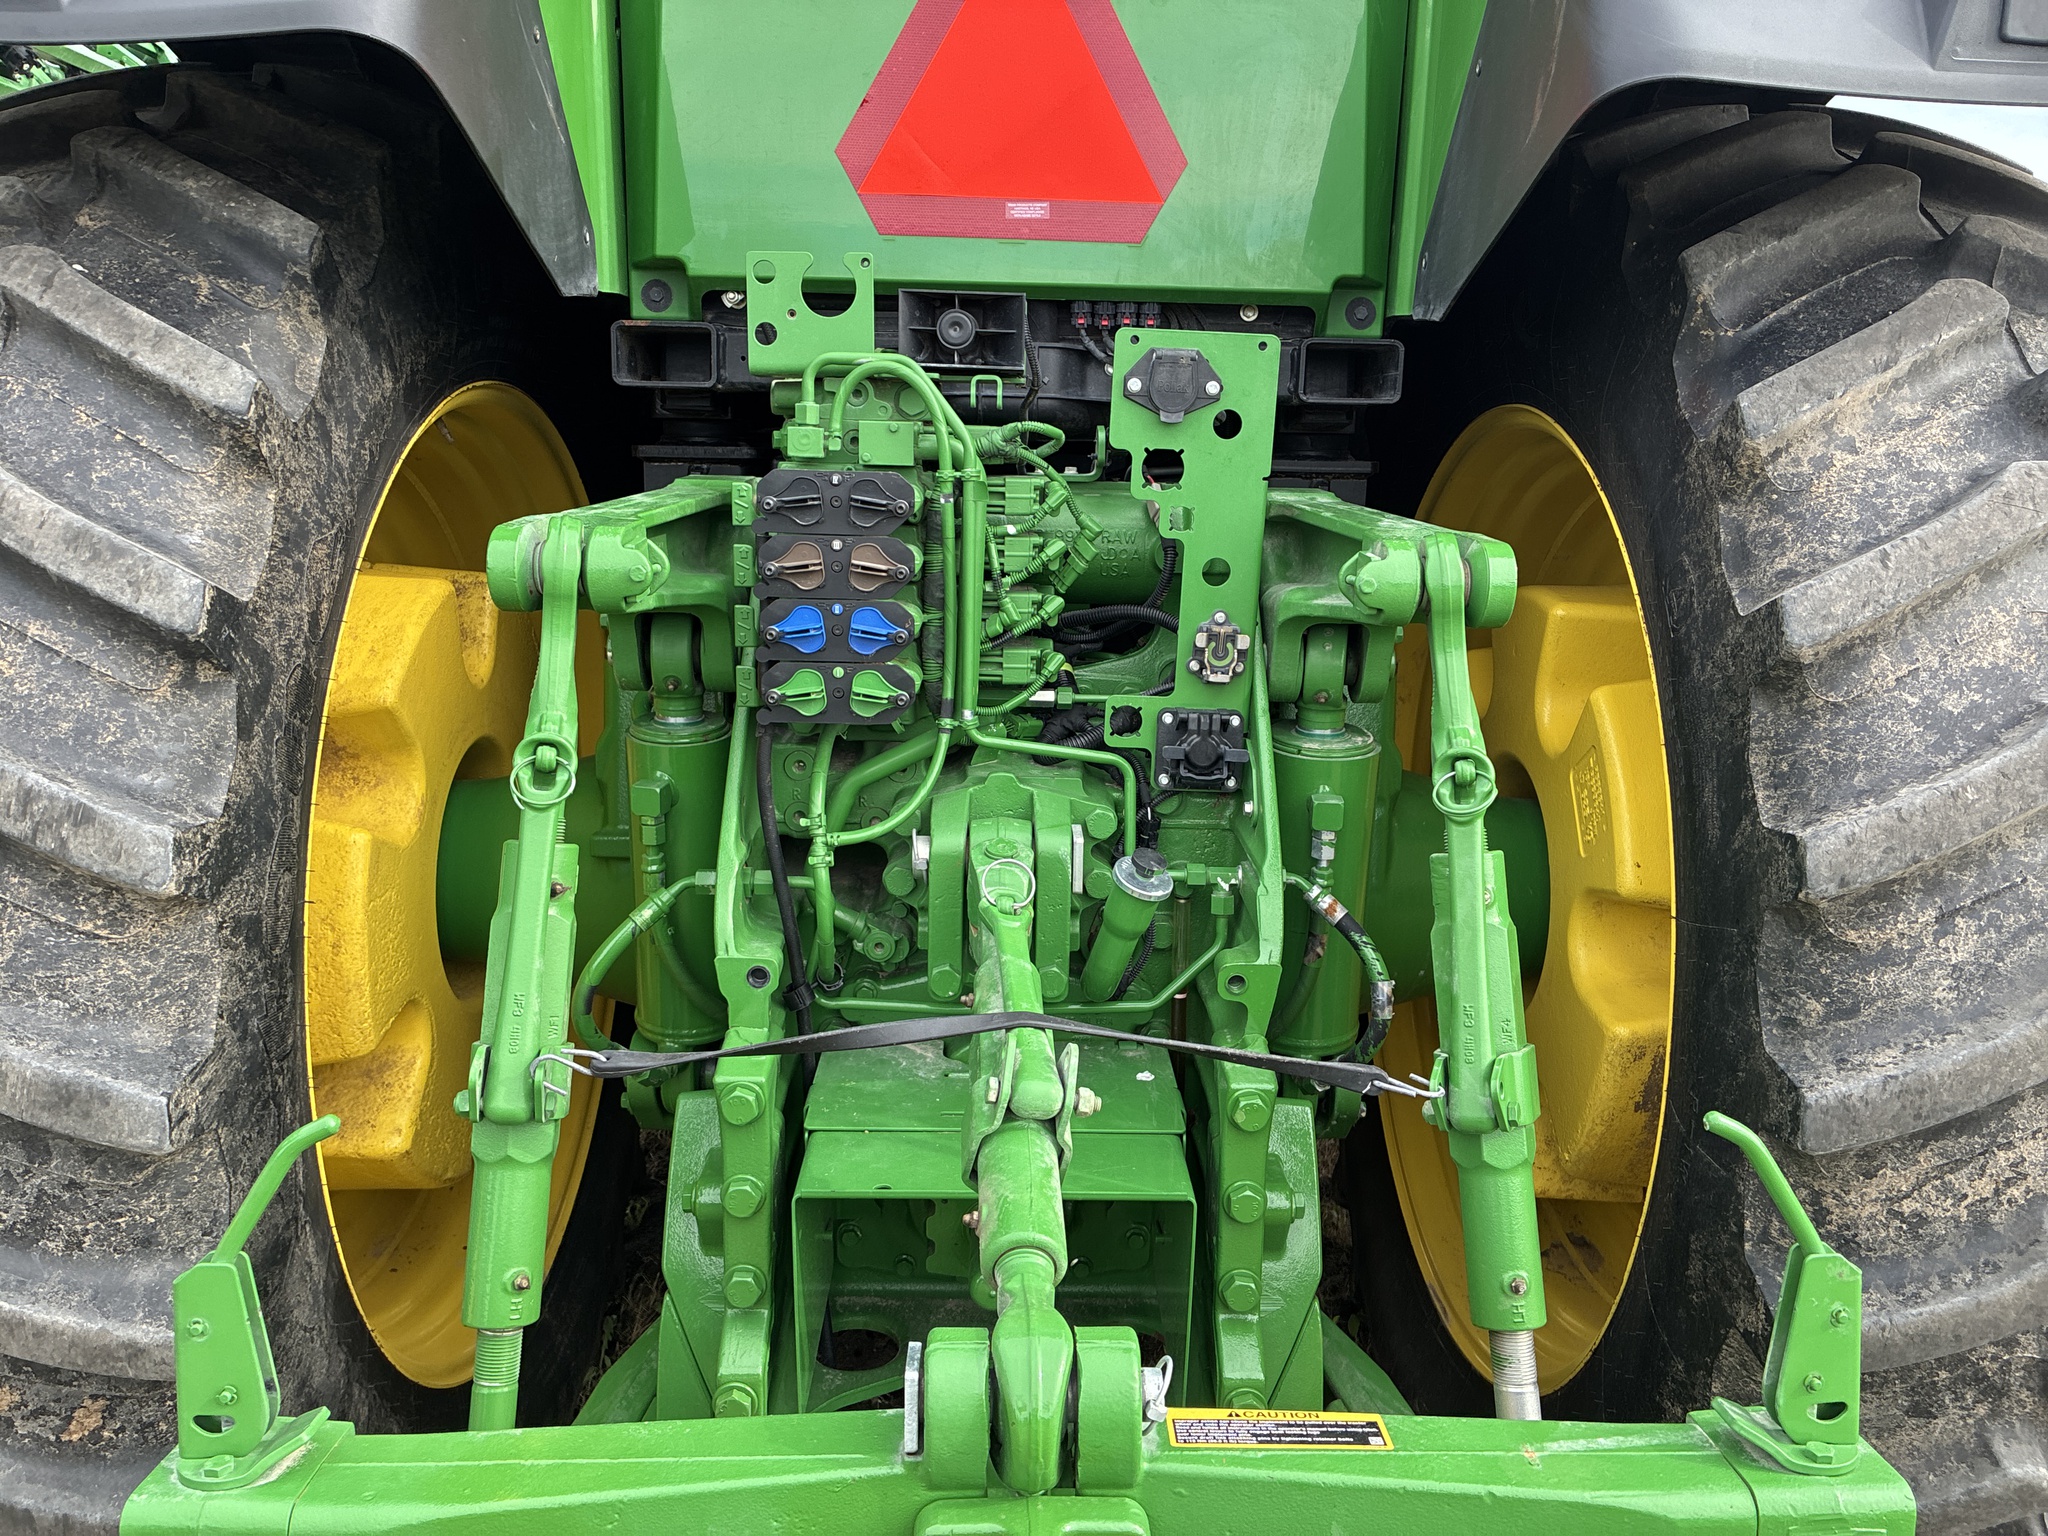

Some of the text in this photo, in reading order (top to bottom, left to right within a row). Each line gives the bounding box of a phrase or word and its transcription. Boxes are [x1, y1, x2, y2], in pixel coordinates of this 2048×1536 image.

[1157, 379, 1190, 394] Pollak
[1101, 529, 1138, 545] RAW
[1100, 562, 1130, 577] USA
[1243, 1411, 1320, 1419] CAUTION
